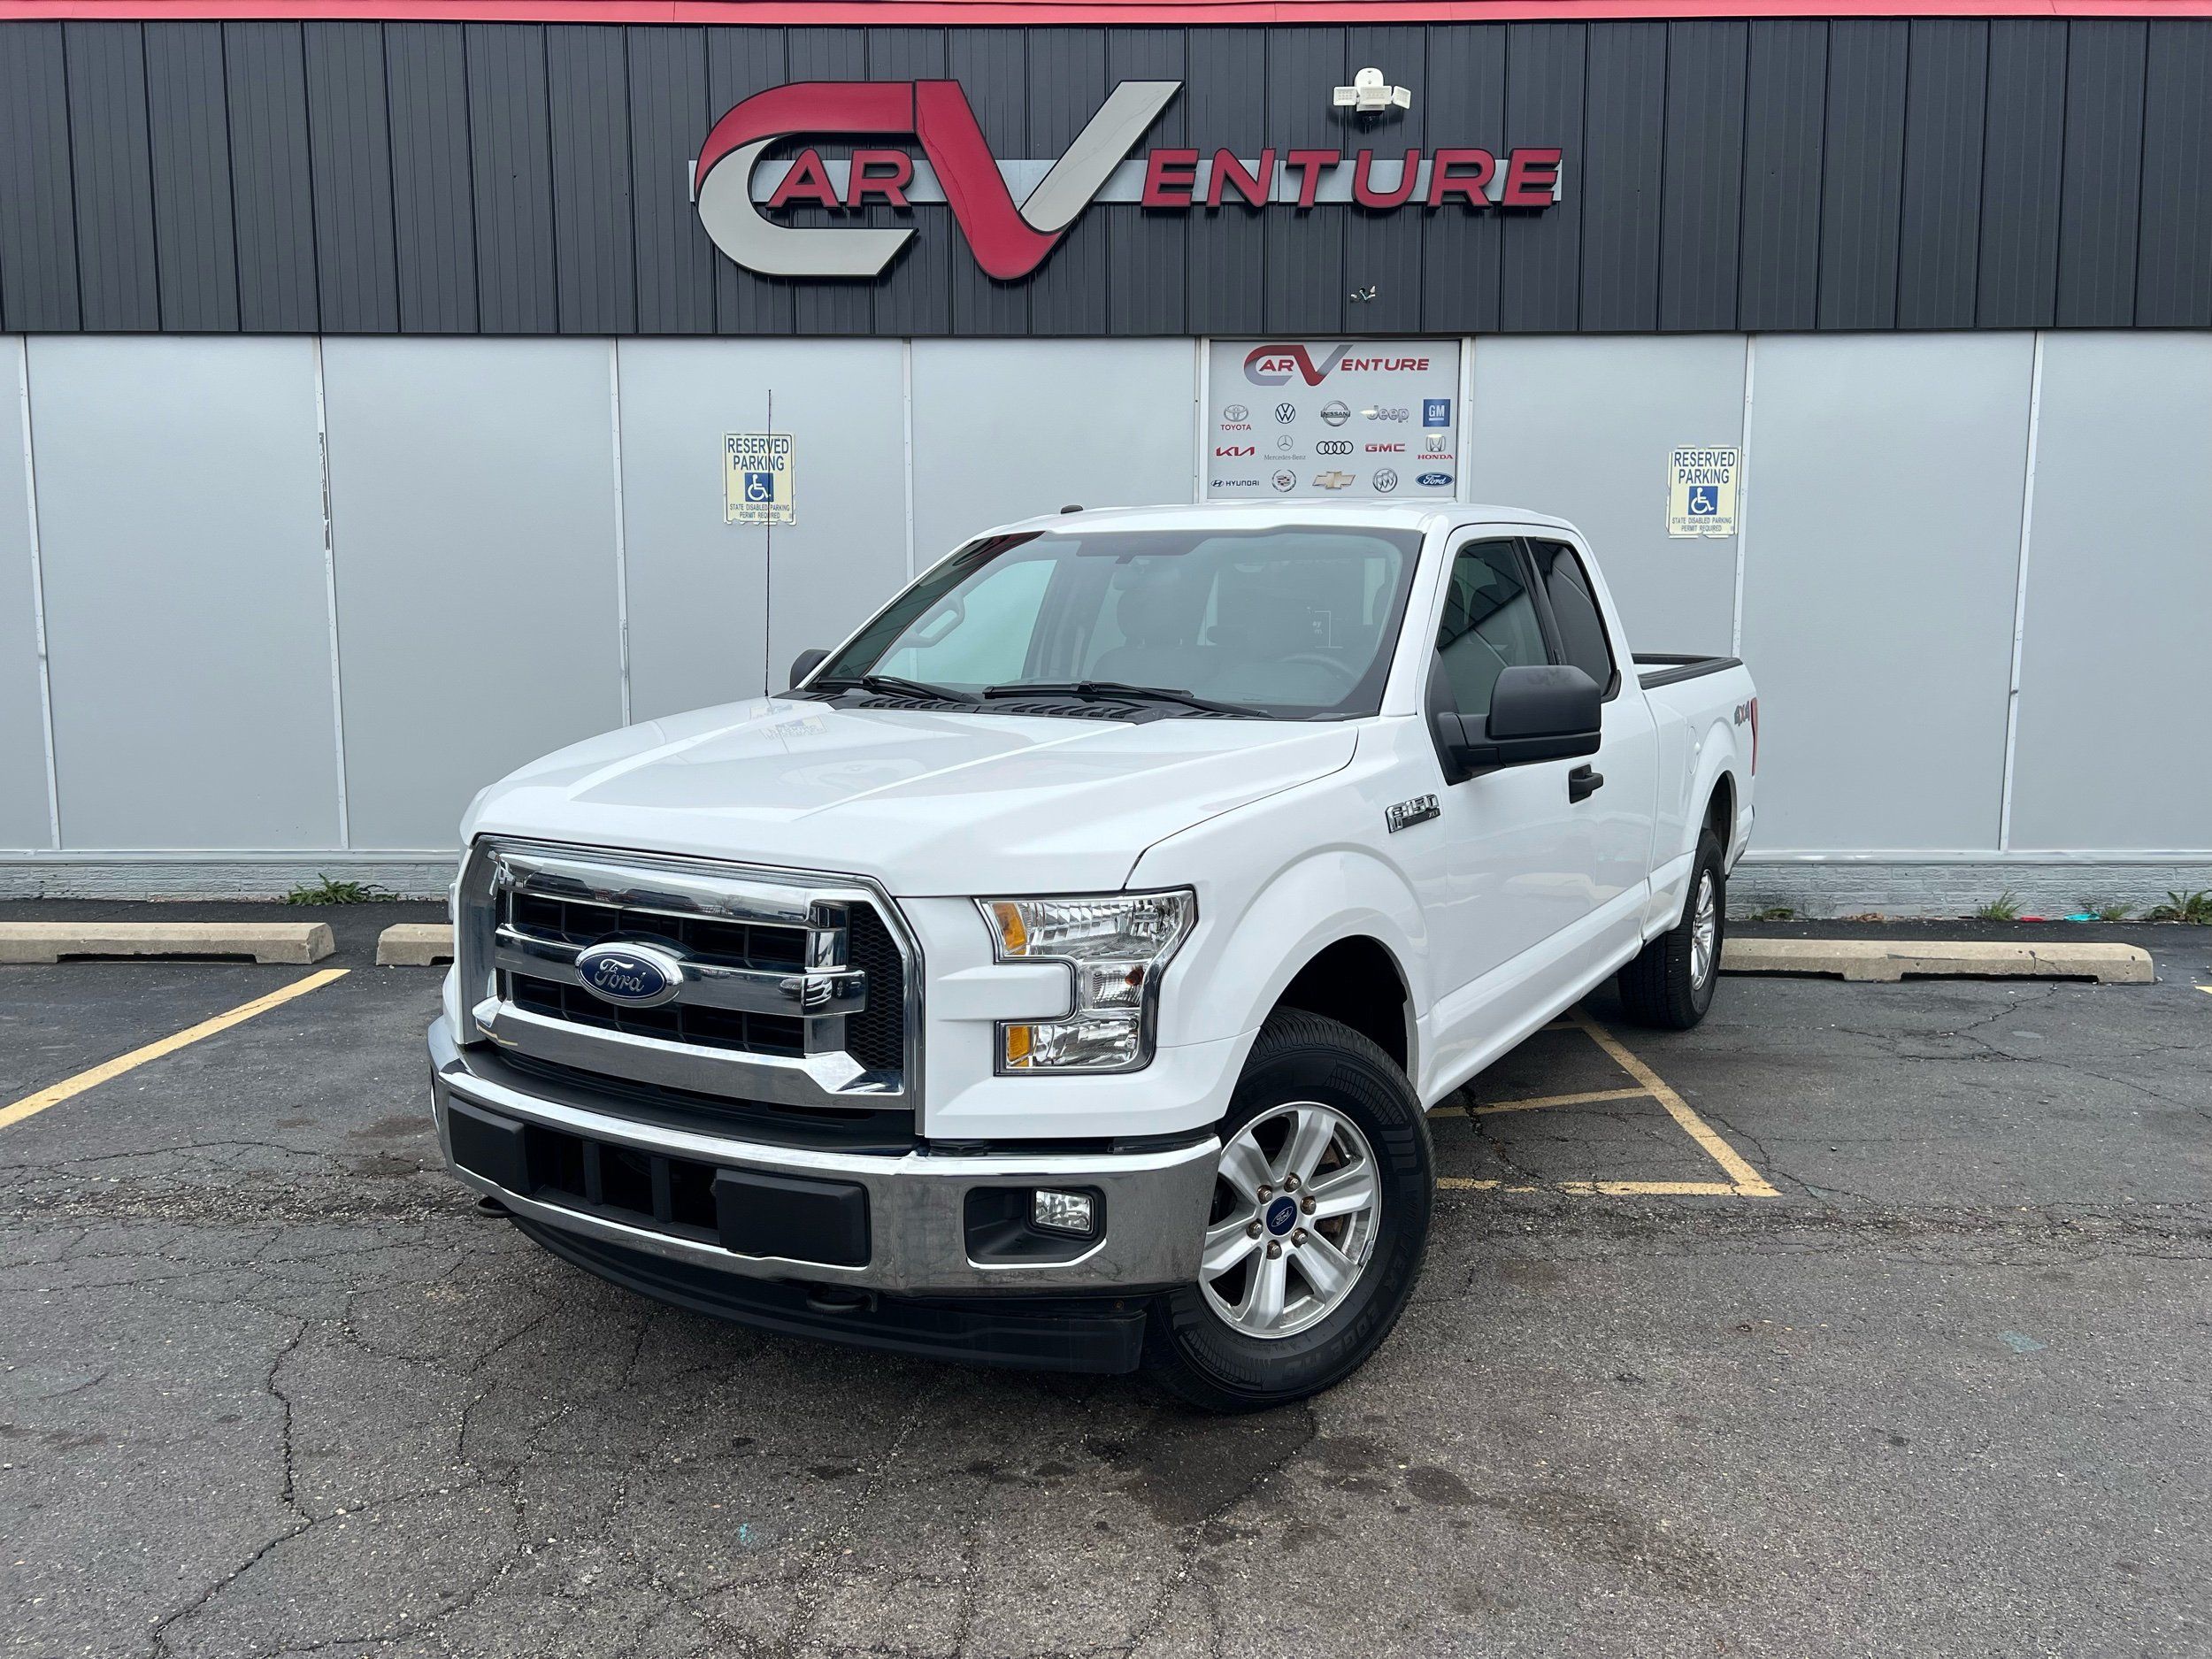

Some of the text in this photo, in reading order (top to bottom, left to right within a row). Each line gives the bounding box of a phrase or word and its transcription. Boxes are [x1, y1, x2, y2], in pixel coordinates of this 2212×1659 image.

[1366, 404, 1409, 423] Jeep
[1428, 404, 1445, 418] GM
[727, 437, 789, 454] RESERVED
[1215, 446, 1256, 457] KIA
[1364, 442, 1406, 452] GMC
[733, 455, 786, 472] PARKING
[1673, 451, 1735, 468] RESERVED
[1422, 474, 1448, 485] Ford
[1678, 468, 1731, 485] PARKING
[594, 957, 647, 993] Ford
